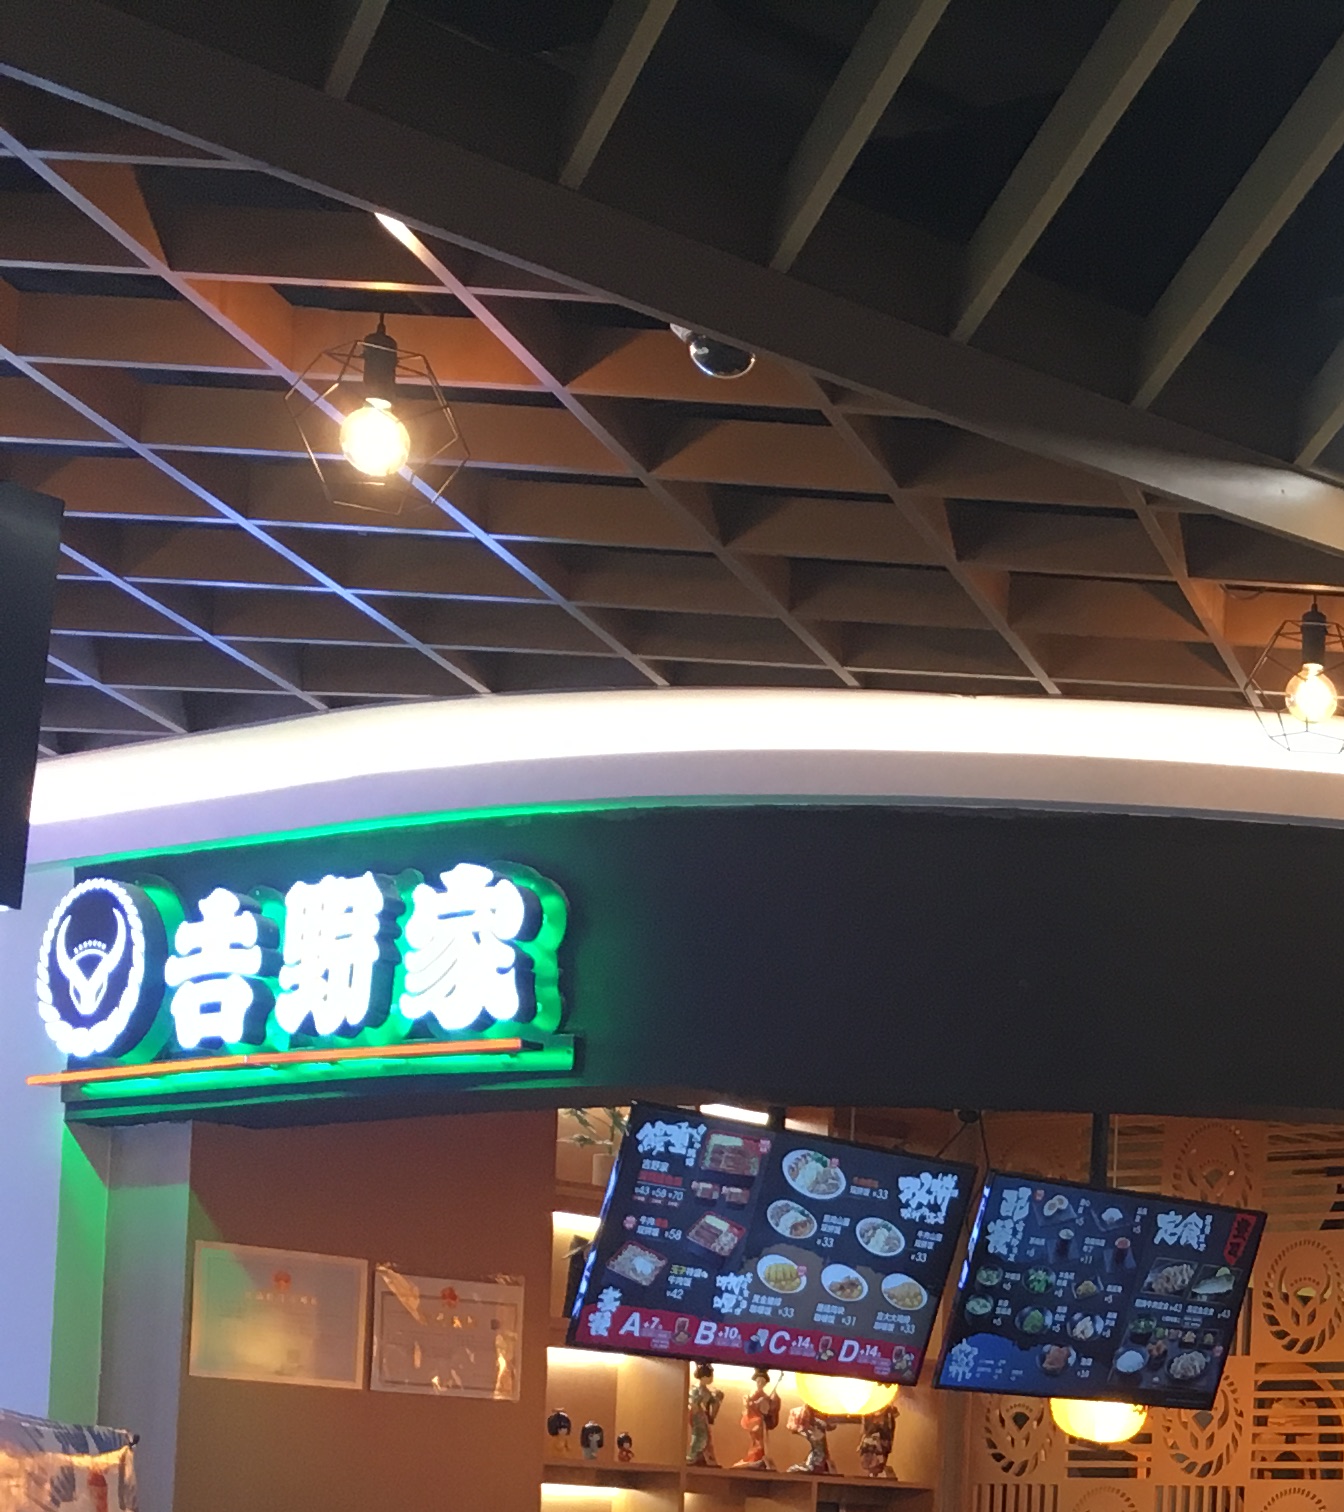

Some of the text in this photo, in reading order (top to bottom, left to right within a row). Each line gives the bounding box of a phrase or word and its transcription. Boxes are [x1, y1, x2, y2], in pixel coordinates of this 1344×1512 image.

[619, 1311, 641, 1337] A
[694, 1320, 717, 1345] B
[769, 1330, 791, 1355] C
[838, 1339, 860, 1363] D
